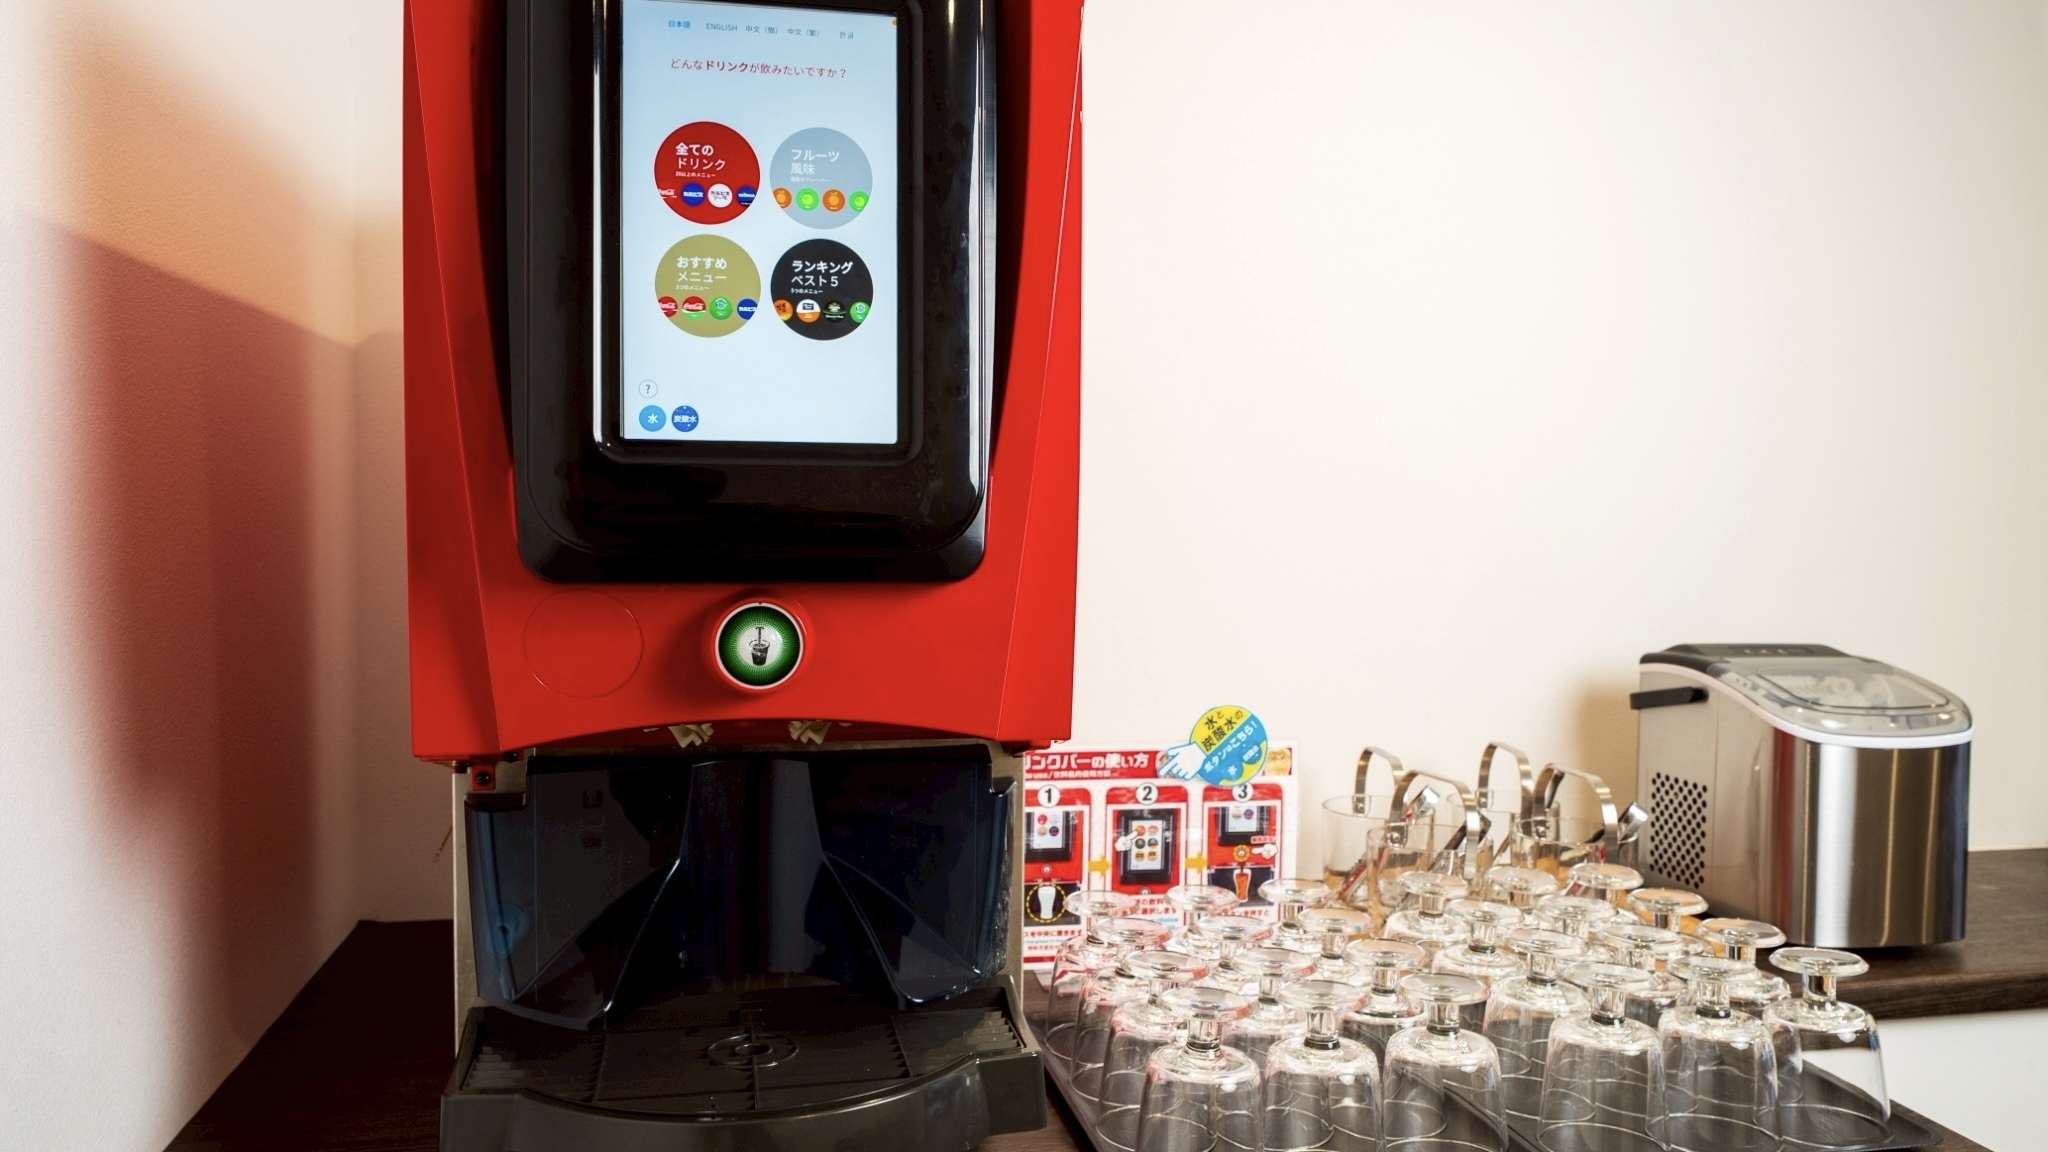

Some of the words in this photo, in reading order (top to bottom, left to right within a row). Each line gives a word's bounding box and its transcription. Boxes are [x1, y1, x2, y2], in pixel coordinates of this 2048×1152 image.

[668, 20, 691, 29] 日本語
[705, 23, 738, 32] ENGLISH
[671, 58, 847, 79] どんなドリンクが飲みたいですか？
[675, 142, 714, 156] 全ての
[791, 149, 840, 162] フルーツ
[678, 157, 726, 171] ドリンク
[790, 162, 816, 175] 風味
[677, 256, 728, 270] おすすめ
[791, 260, 853, 274] ランキング
[677, 271, 727, 282] メニュー
[647, 413, 659, 424] 水
[674, 414, 698, 423] 炭酸水
[1204, 710, 1225, 730] 水と
[1201, 710, 1243, 752] 炭酸水の
[1044, 788, 1052, 804] 1
[1142, 785, 1153, 801] 2
[1238, 783, 1248, 799] 3
